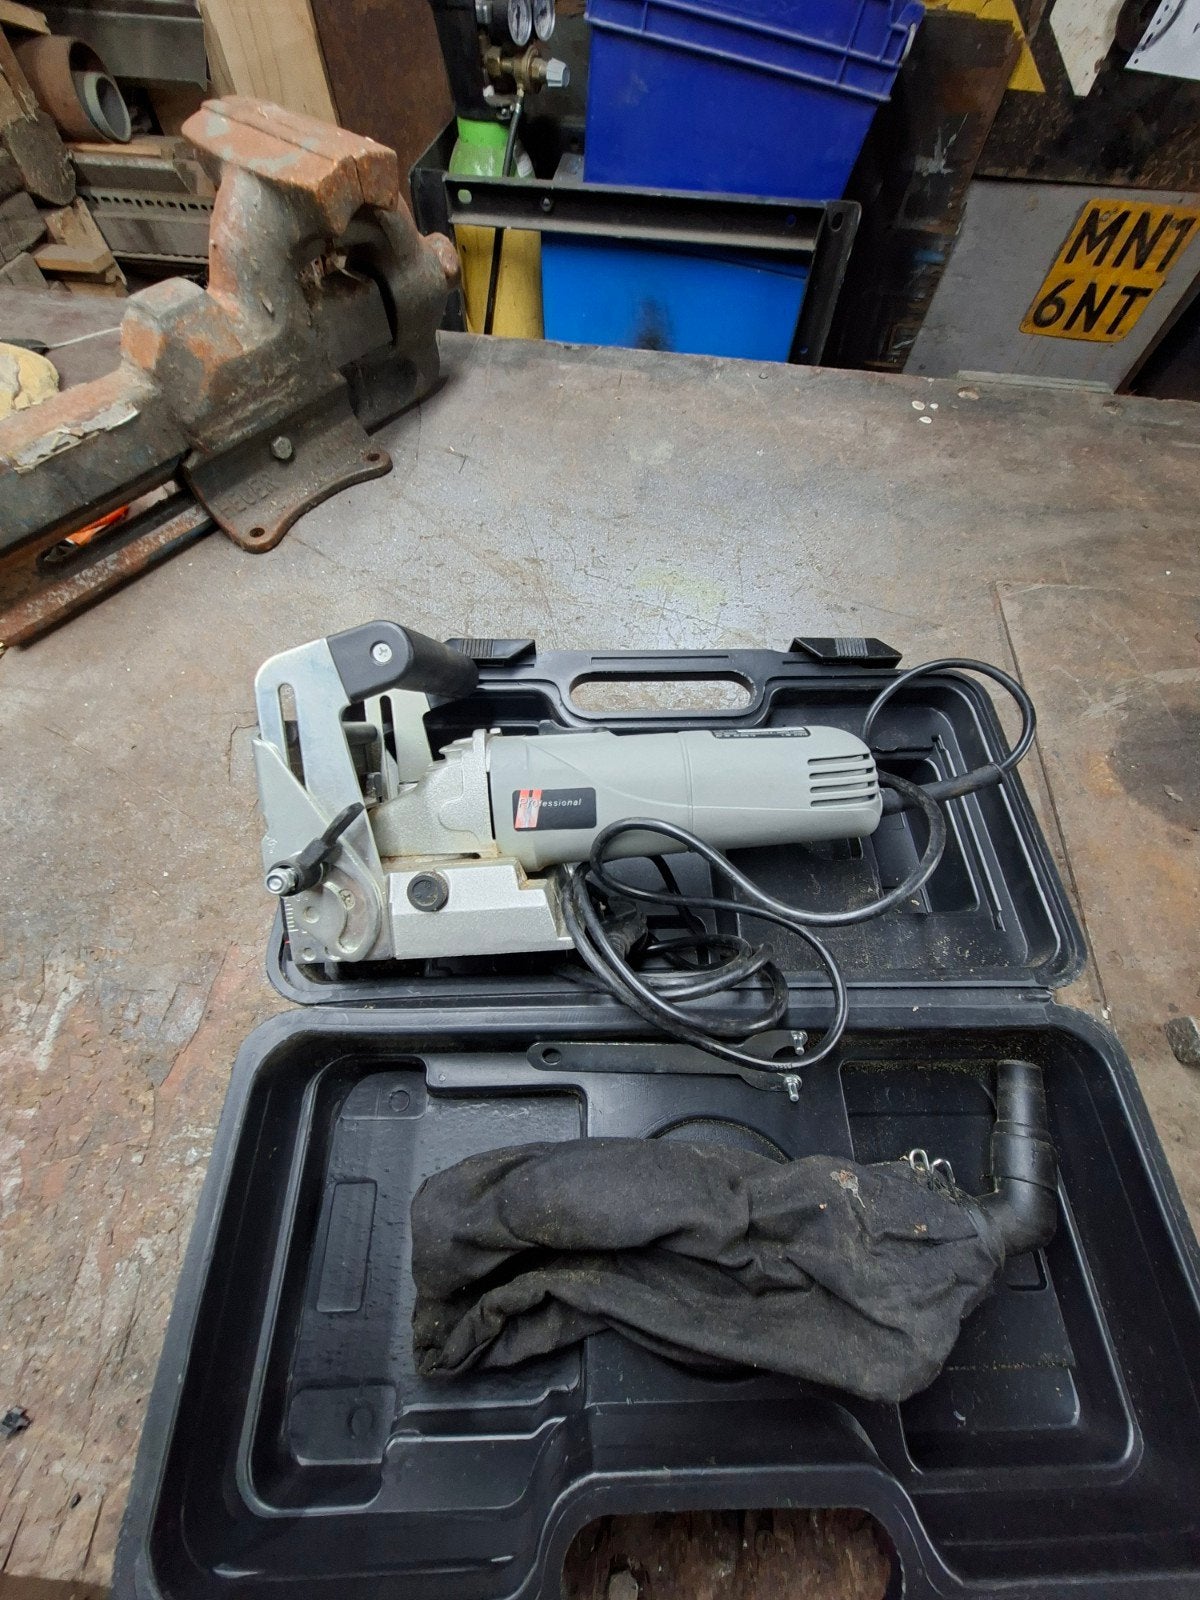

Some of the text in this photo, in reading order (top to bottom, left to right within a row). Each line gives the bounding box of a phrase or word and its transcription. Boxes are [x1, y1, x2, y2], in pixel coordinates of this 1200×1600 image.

[1064, 208, 1196, 273] MN1
[1033, 278, 1153, 334] 6NT
[519, 798, 582, 809] Professional
